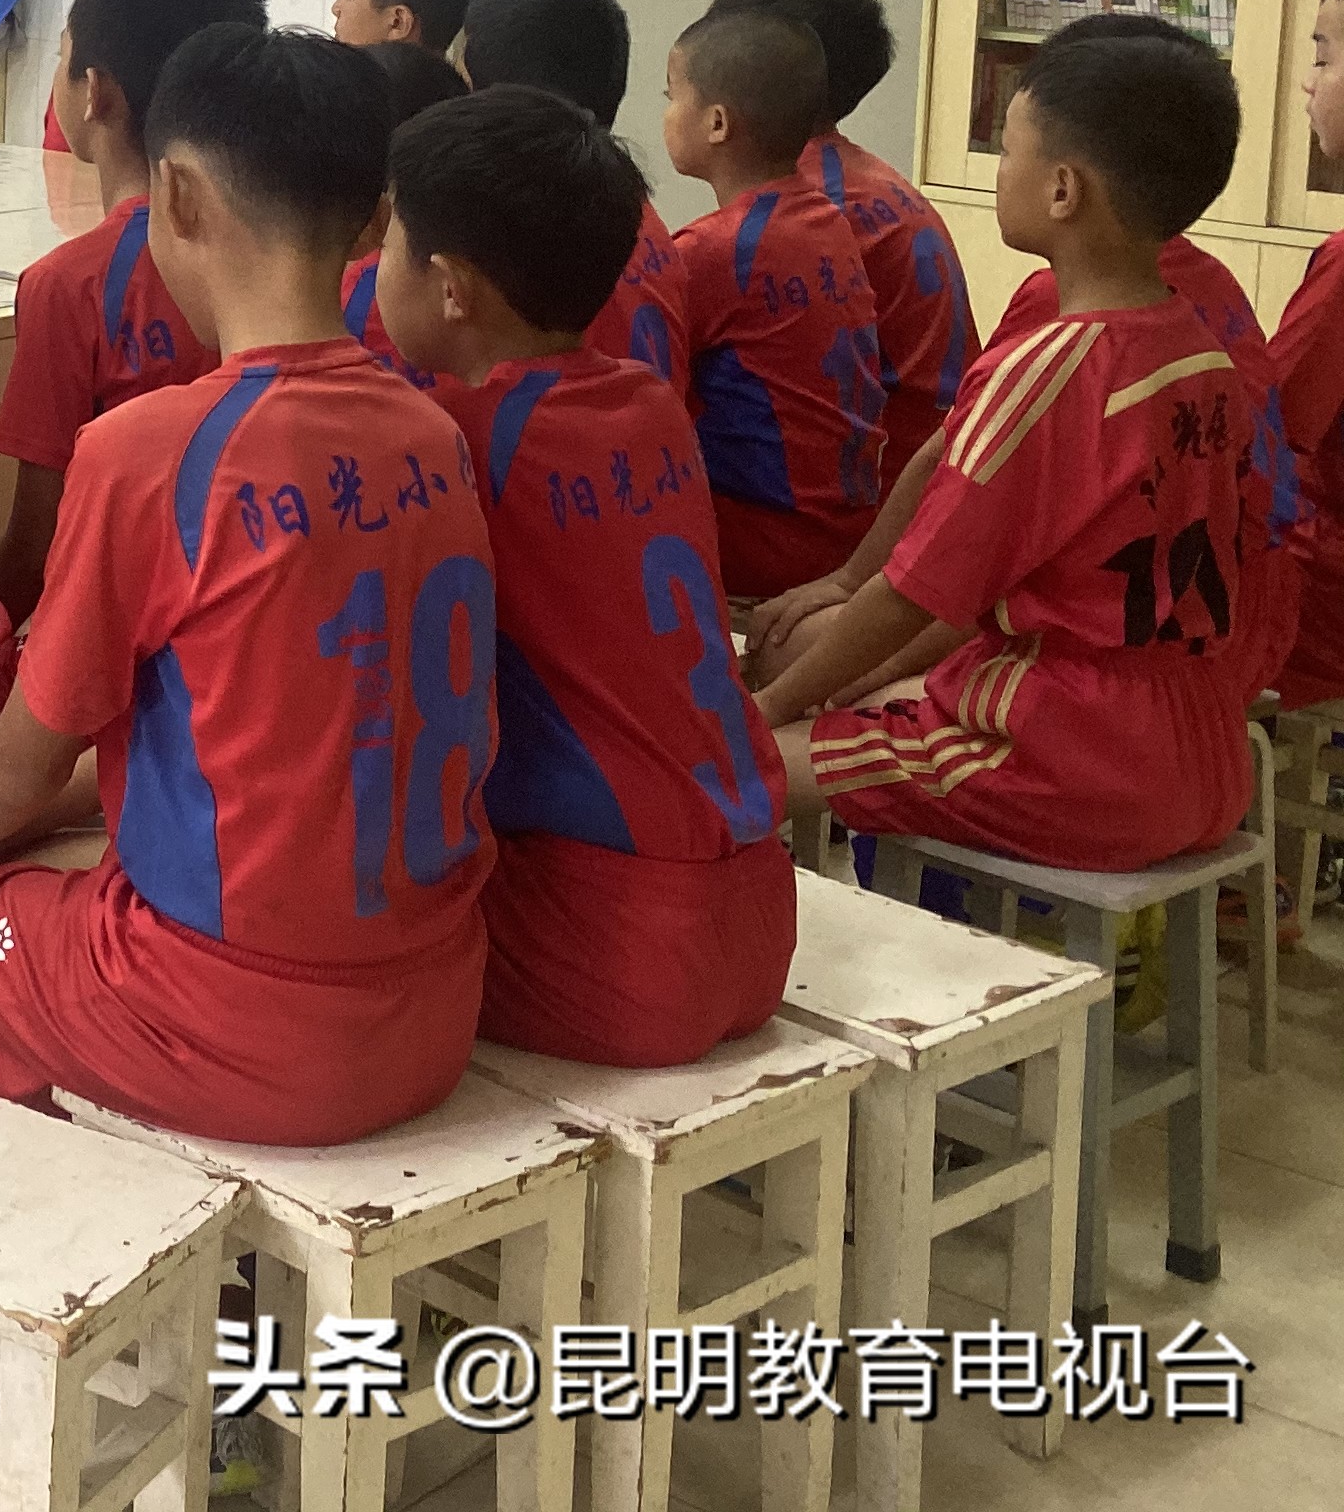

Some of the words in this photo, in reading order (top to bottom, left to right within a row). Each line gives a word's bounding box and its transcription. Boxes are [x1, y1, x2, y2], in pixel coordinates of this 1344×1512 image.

[548, 447, 706, 530] 阳光小
[316, 555, 497, 918] 18
[641, 534, 772, 844] 3
